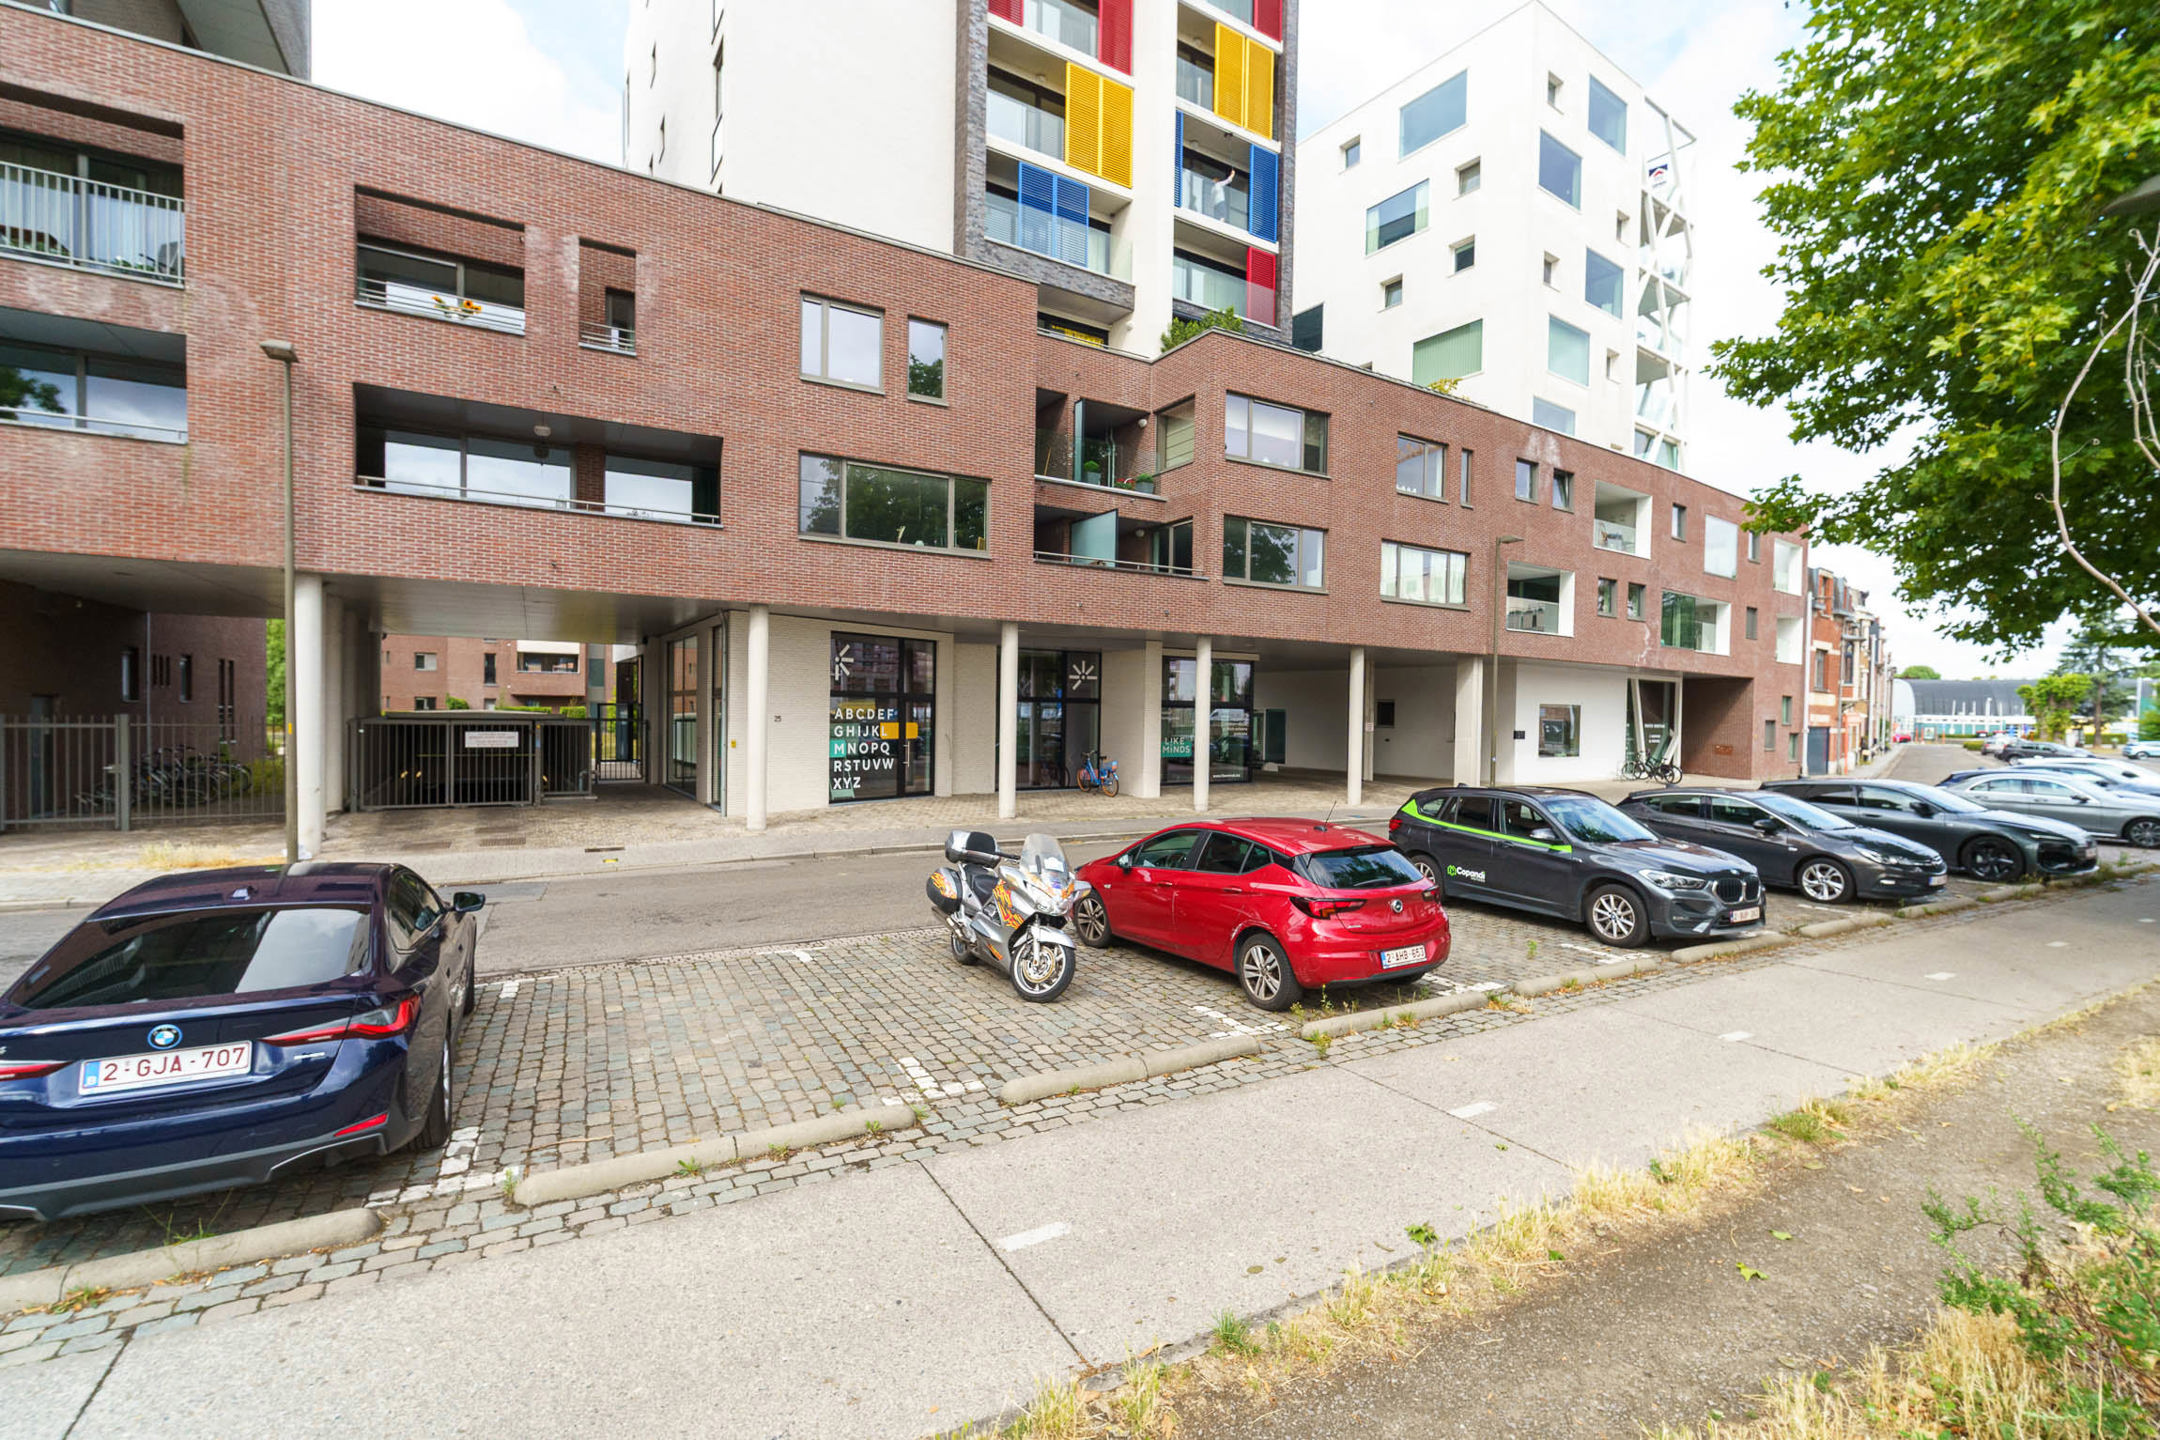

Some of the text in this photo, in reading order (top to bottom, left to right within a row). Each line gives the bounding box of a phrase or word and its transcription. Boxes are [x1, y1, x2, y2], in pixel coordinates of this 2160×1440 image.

[834, 708, 894, 720] ABCDEF
[834, 725, 887, 737] GHIJKL
[834, 742, 890, 755] MNOPQ
[834, 758, 894, 772] RSTUVW
[833, 777, 861, 789] XYZ
